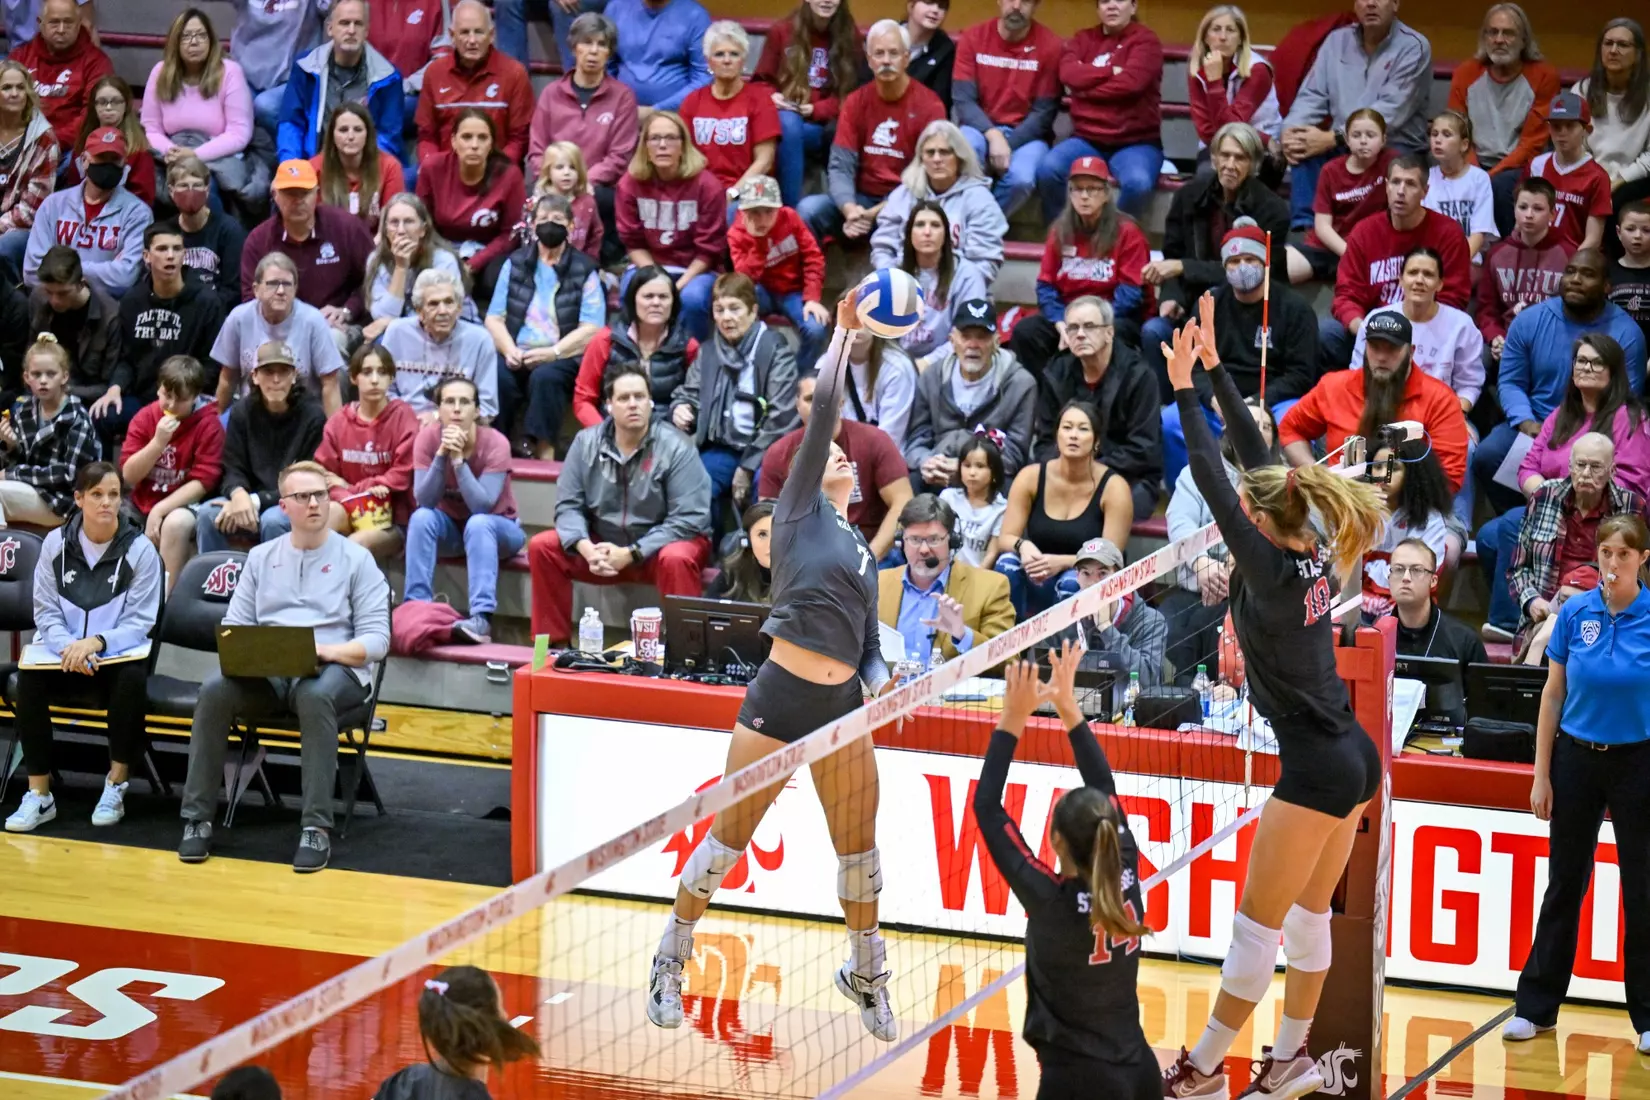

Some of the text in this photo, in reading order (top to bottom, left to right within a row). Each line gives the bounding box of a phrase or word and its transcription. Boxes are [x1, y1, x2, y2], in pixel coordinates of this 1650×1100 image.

[693, 117, 748, 145] WSU
[55, 219, 122, 250] WSU
[1497, 267, 1563, 294] WSU
[159, 327, 181, 340] BAY
[856, 543, 873, 576] 7
[1303, 575, 1331, 628] 10
[635, 621, 657, 633] WSU
[1585, 633, 1595, 642] 12
[638, 649, 657, 658] COU
[639, 638, 658, 650] GO
[924, 773, 1625, 982] WSHGTO
[1088, 899, 1140, 966] 14
